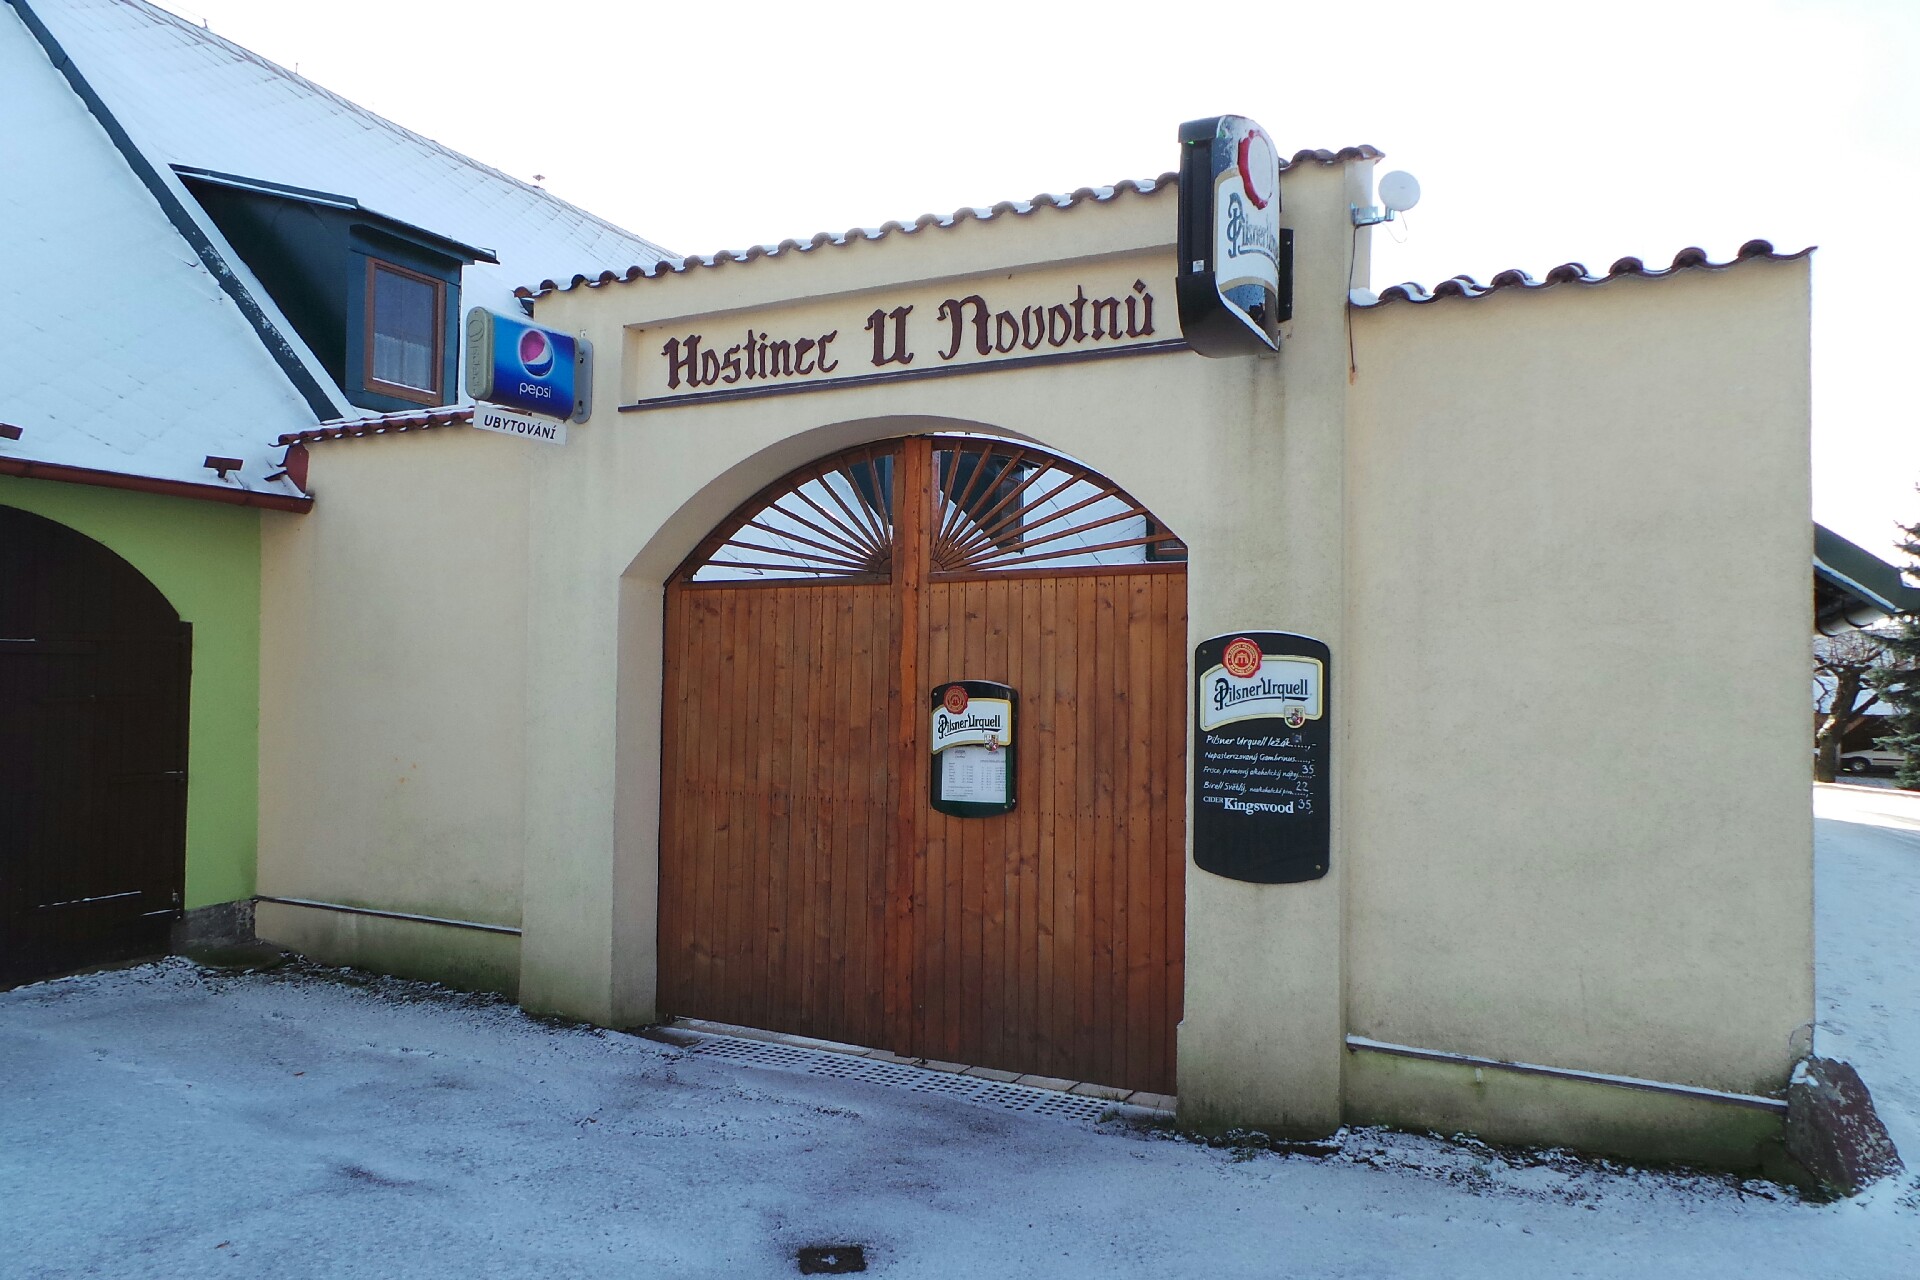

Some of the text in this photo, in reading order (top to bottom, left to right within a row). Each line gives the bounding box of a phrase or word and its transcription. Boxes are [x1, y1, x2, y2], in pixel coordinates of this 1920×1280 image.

[660, 328, 839, 390] Hostinec
[865, 303, 914, 367] U
[519, 382, 552, 399] pepsi
[484, 414, 557, 440] UBYTOVÁNÍ
[1214, 676, 1308, 711] Pilsner Urquell
[938, 713, 1001, 739] Pilsner Urquell
[1205, 735, 1235, 745] Pilsner
[1236, 736, 1268, 750] Urquell
[1259, 753, 1296, 763] Gambrinus
[1203, 796, 1223, 804] CIDER
[1224, 797, 1295, 815] Kingswood
